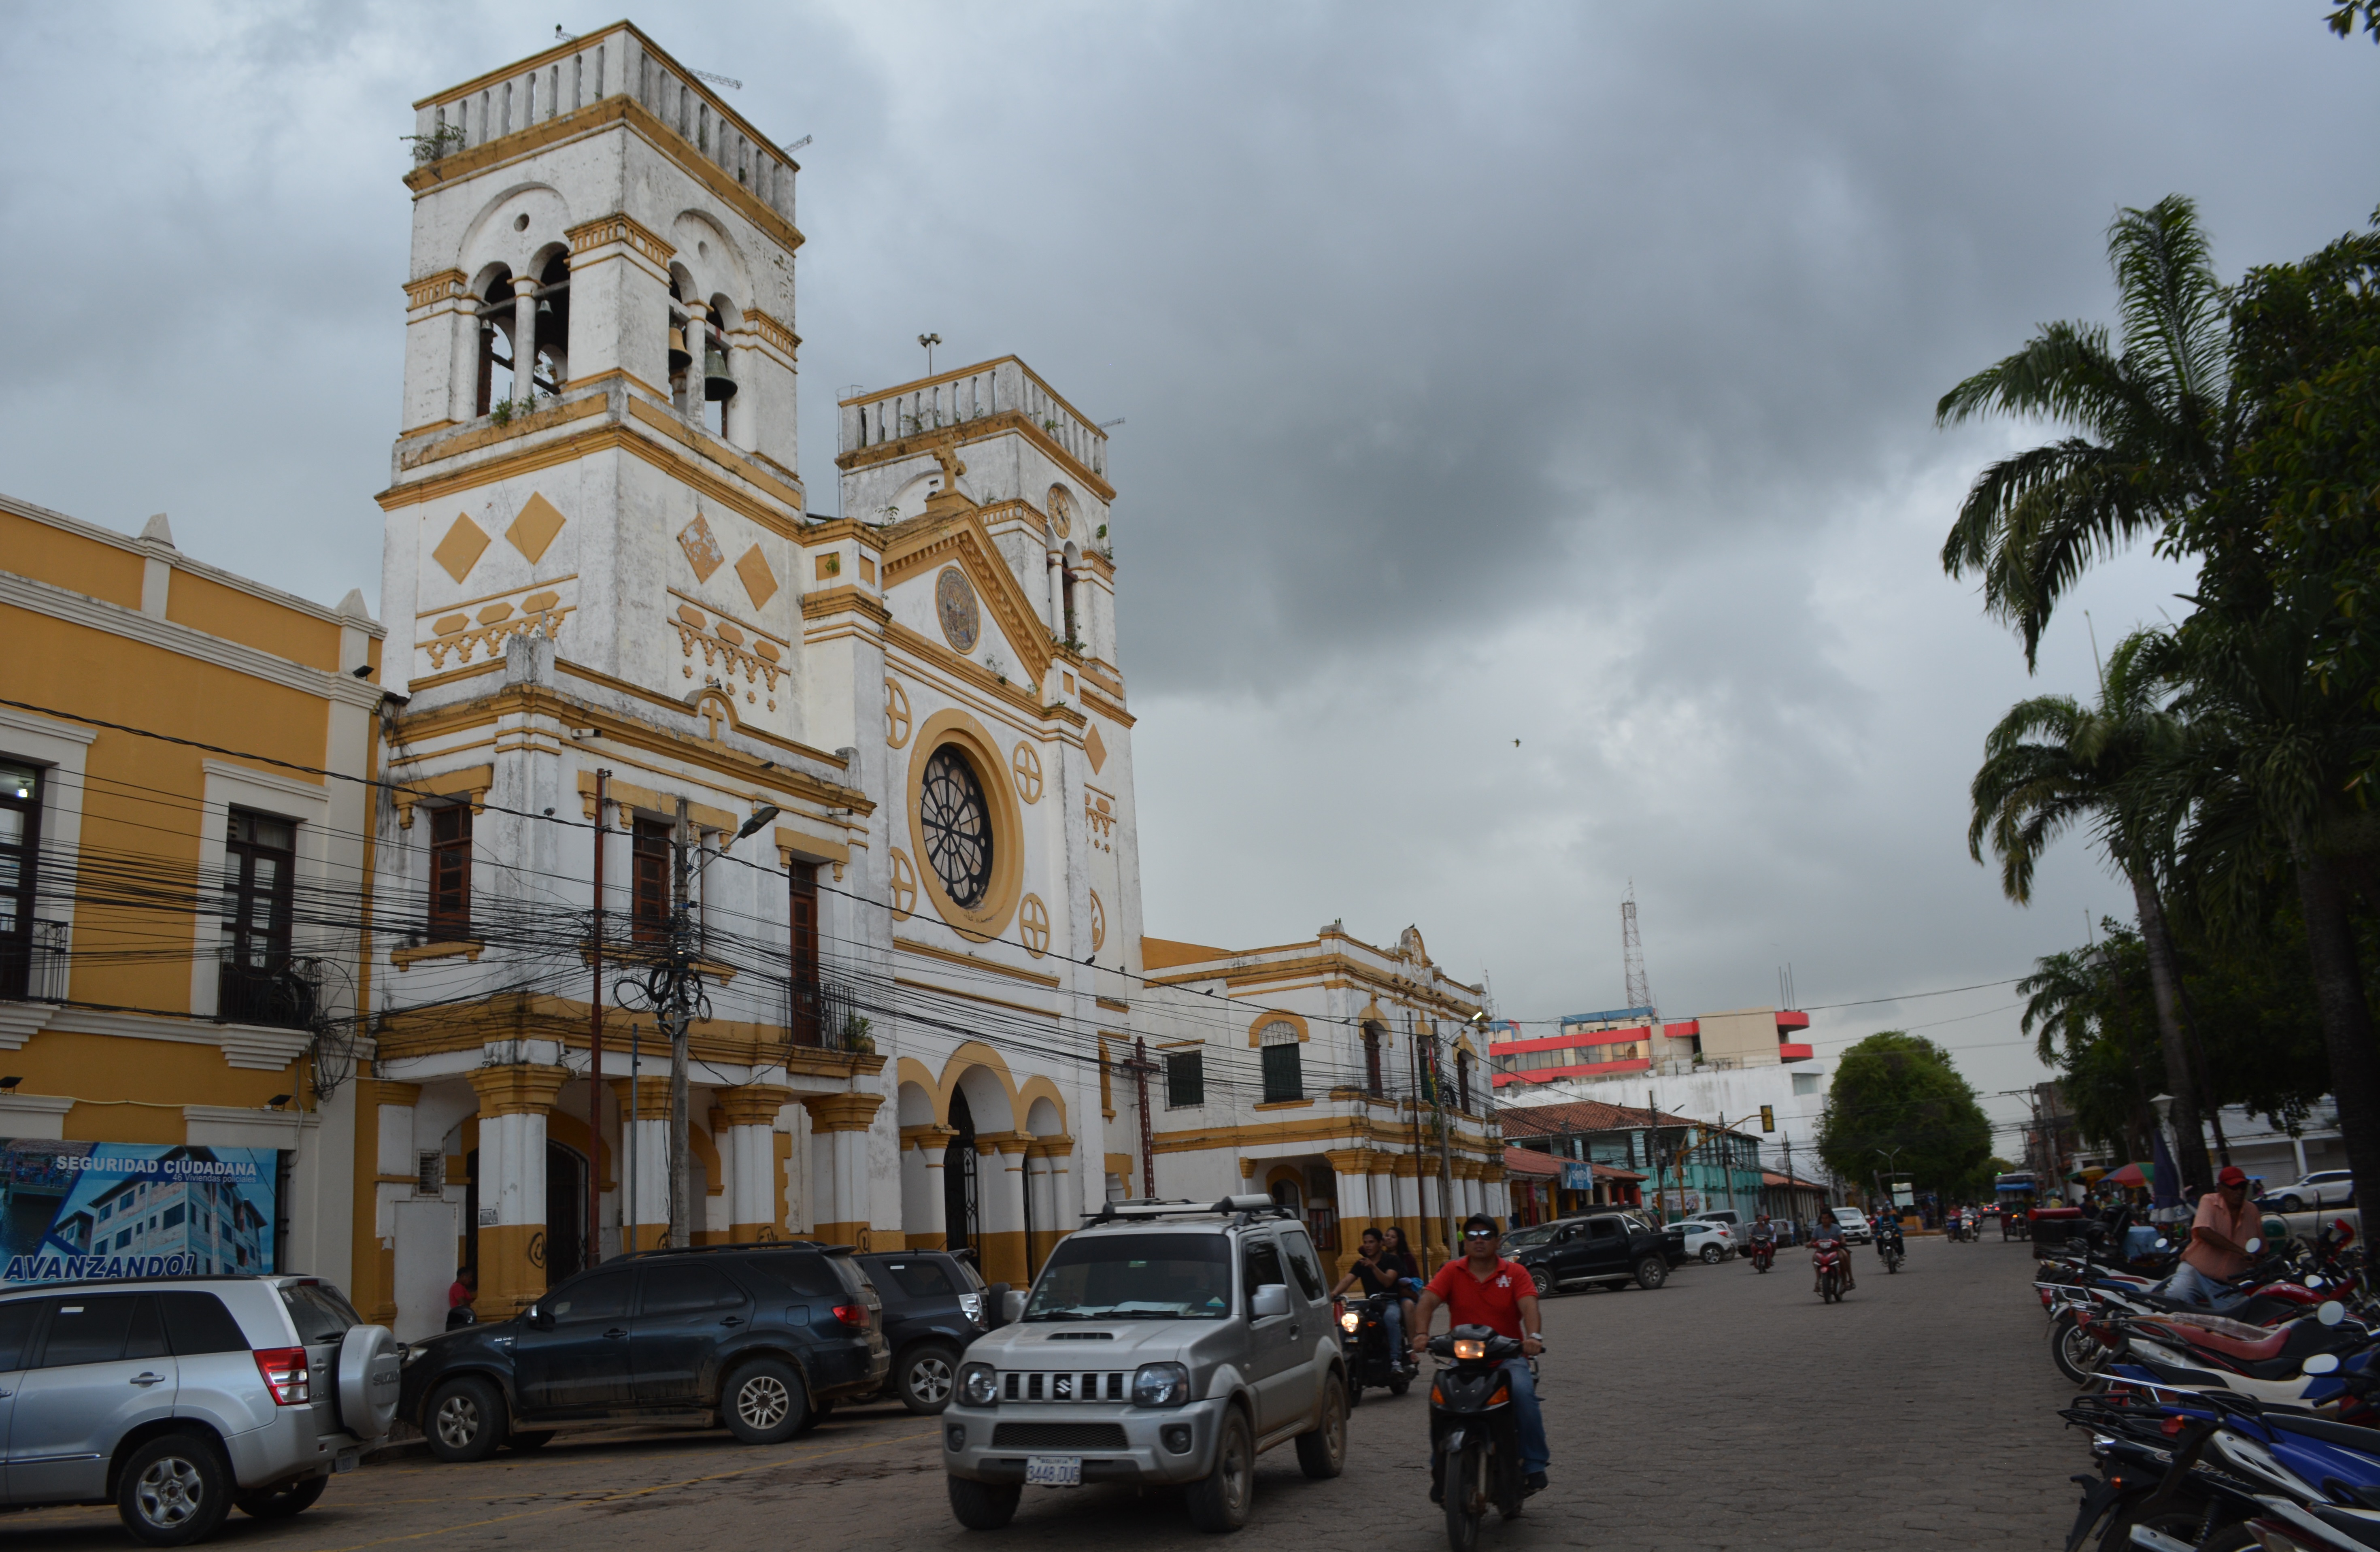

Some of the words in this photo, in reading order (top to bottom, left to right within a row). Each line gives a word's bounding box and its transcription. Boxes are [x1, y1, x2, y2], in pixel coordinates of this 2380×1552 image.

[57, 1156, 158, 1173] SEGURIDAD
[164, 1160, 256, 1175] CIUDADANA
[185, 1173, 221, 1182] Viviendas
[223, 1175, 256, 1183] policiales
[3, 1255, 194, 1280] AVANZANDO!
